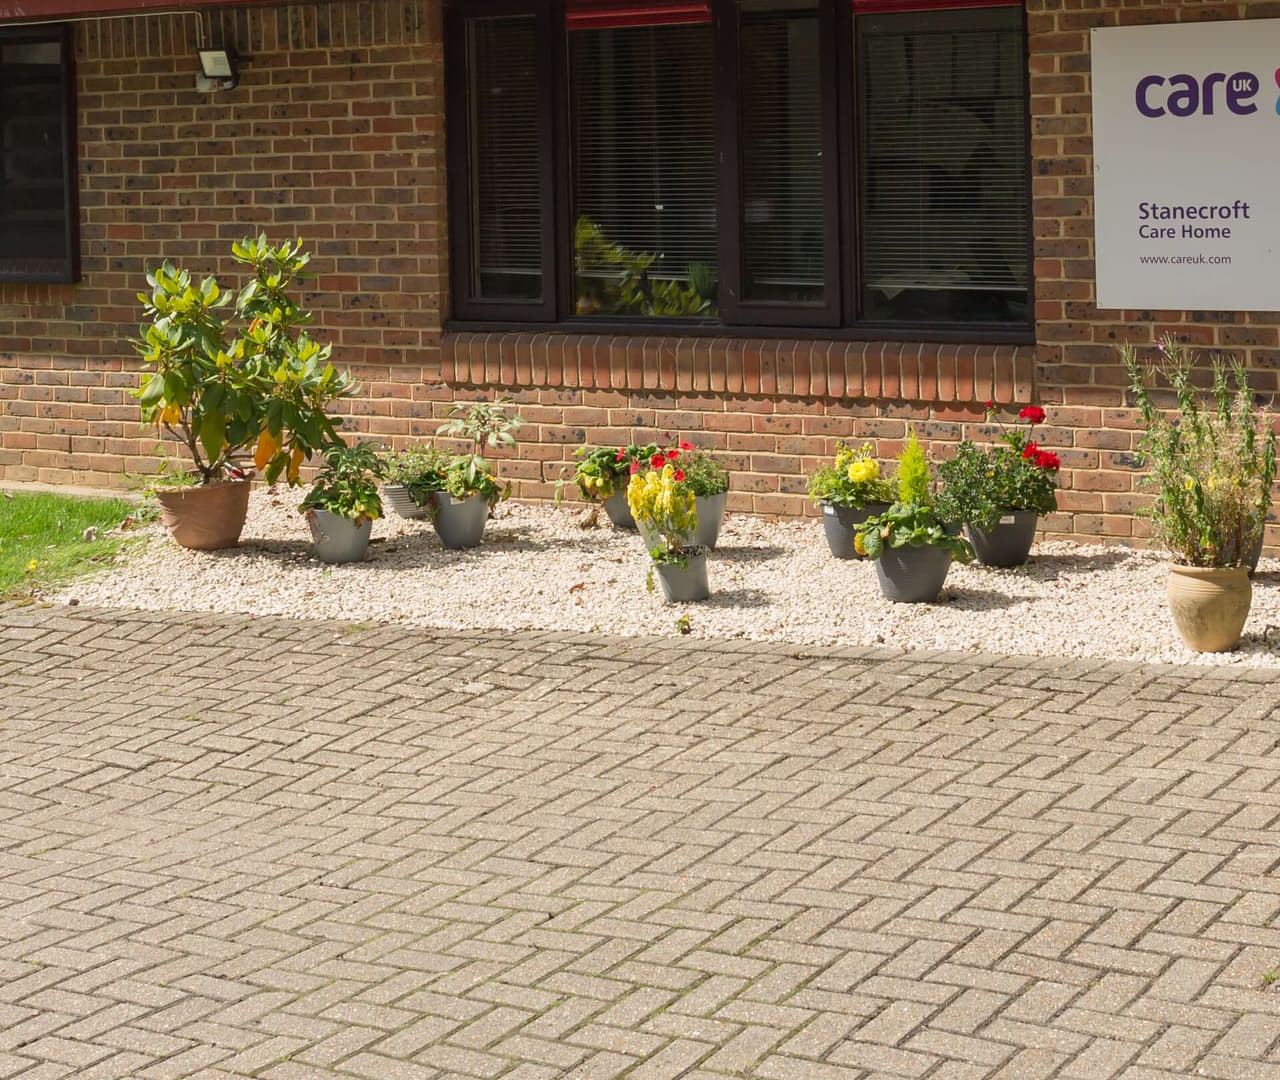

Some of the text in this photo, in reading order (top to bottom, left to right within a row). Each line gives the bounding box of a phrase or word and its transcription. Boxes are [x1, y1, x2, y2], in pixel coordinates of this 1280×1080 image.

[1135, 71, 1259, 118] care UK
[1138, 200, 1250, 220] Stanecroft
[1138, 224, 1231, 239] Care Home
[1139, 254, 1232, 264] www.careuk.com
